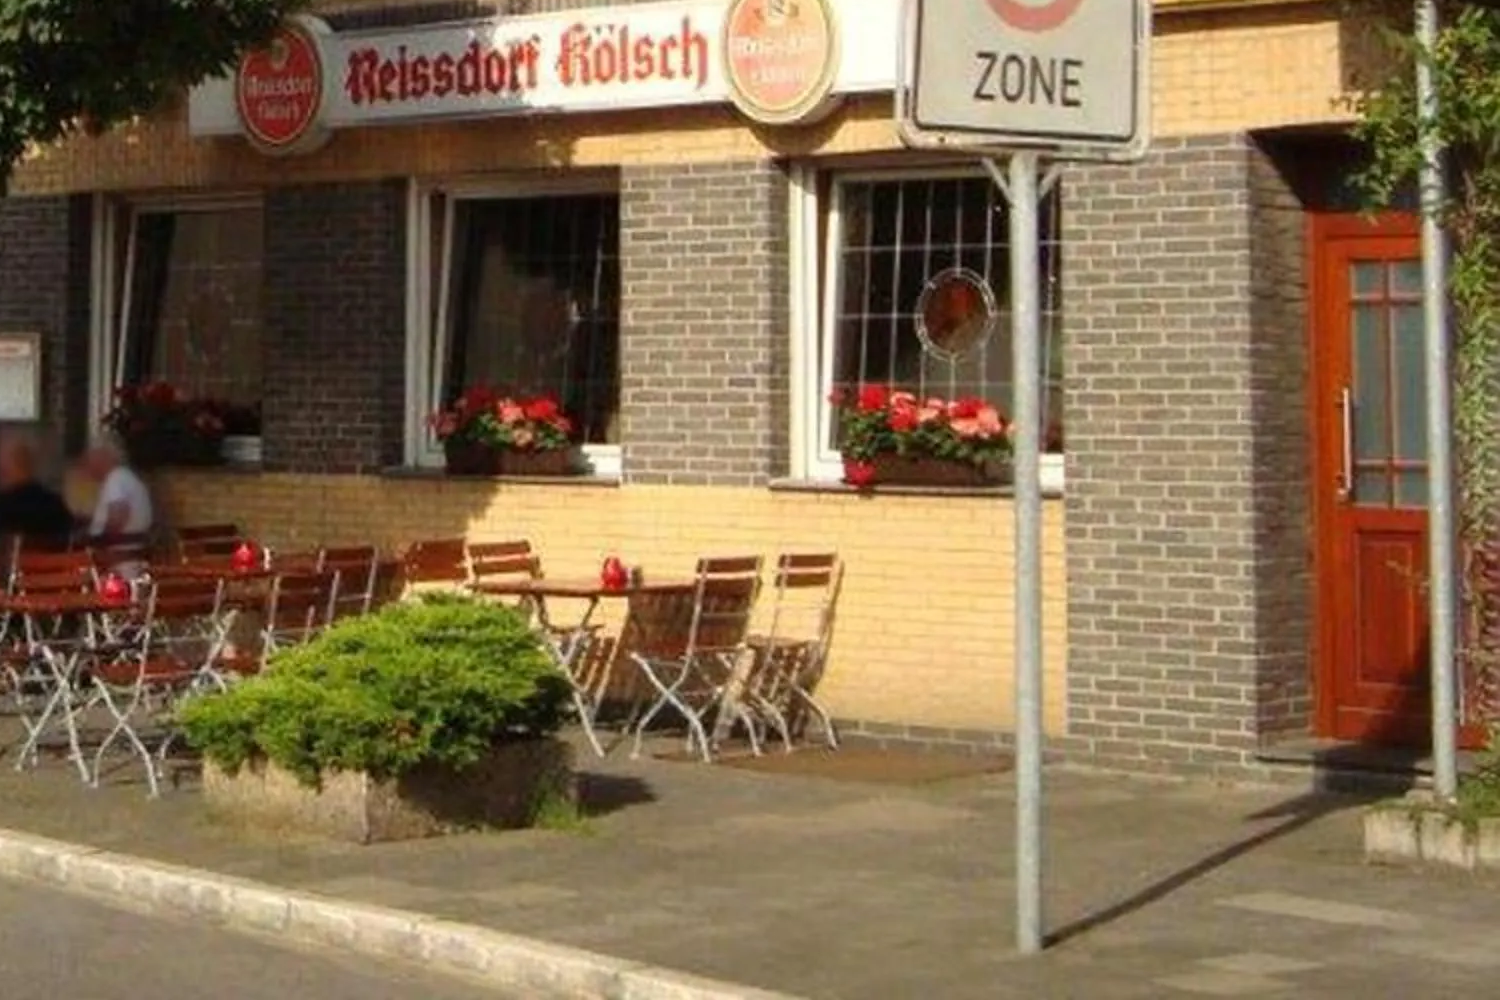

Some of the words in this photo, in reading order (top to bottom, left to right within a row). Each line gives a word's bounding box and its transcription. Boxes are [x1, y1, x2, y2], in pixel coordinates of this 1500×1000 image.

[345, 34, 540, 104] Reissdorf
[555, 15, 709, 90] Kölsch
[973, 51, 1084, 108] ZONE
